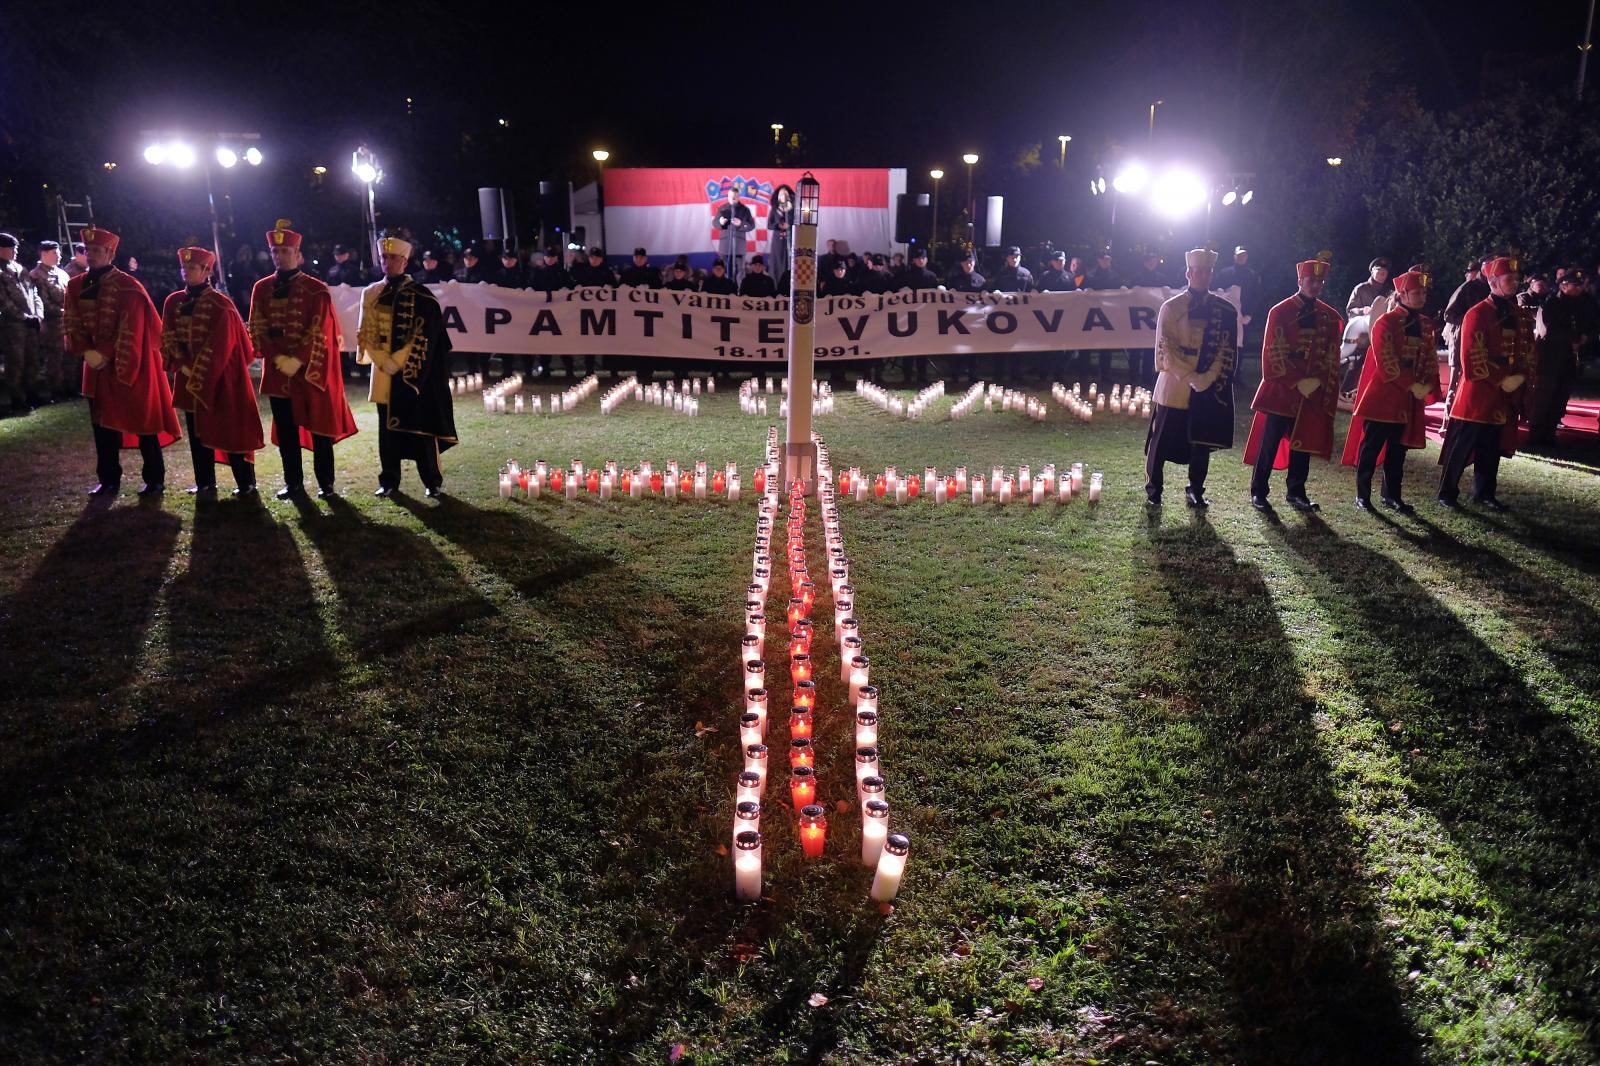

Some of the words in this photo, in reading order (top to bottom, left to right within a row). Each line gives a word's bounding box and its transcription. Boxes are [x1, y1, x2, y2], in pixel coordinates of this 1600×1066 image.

[671, 293, 732, 310] vam
[873, 288, 955, 312] jednu
[442, 305, 785, 344] APAMTITE
[837, 306, 1157, 341] VUKOVAR
